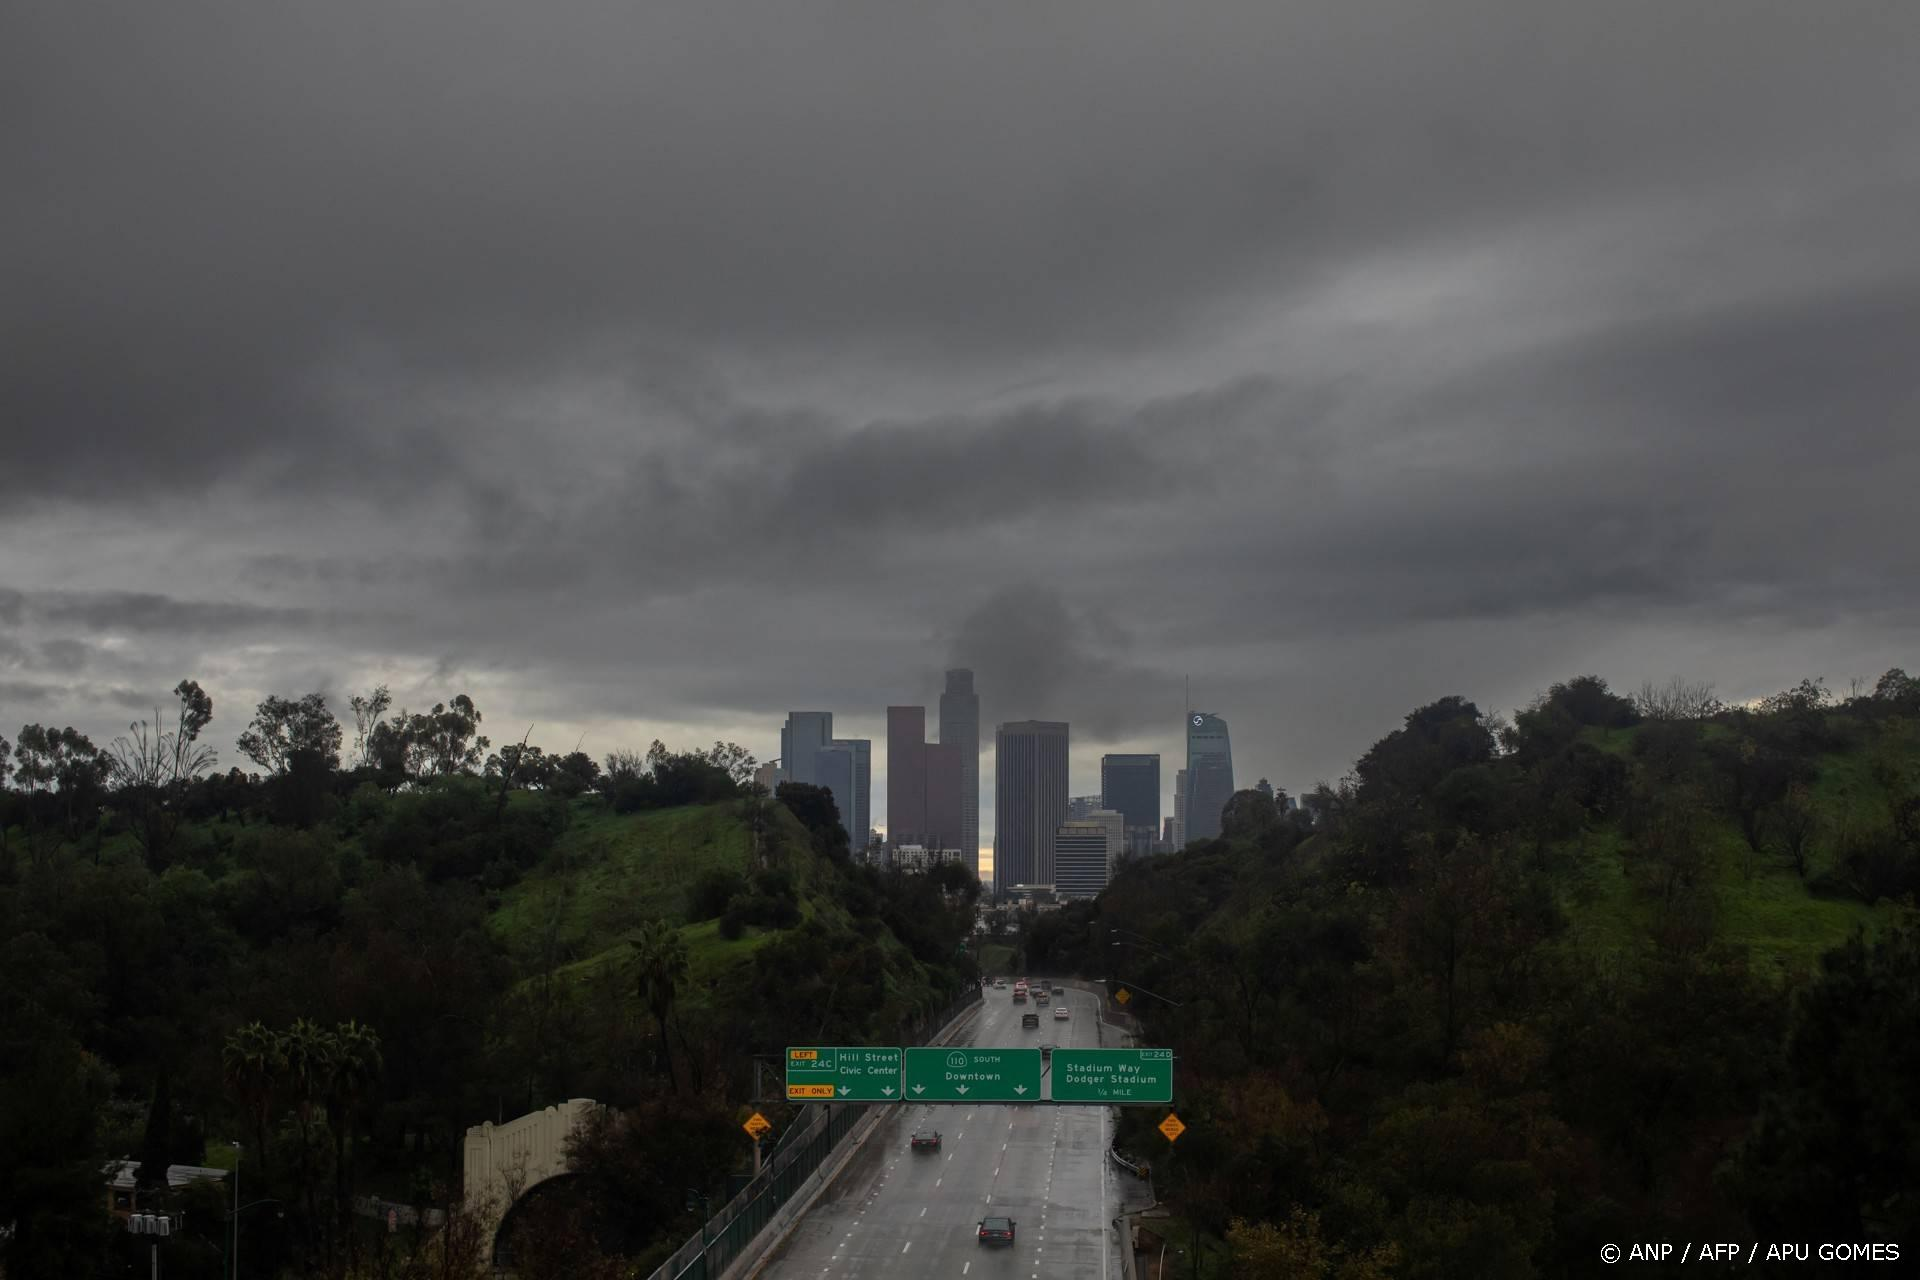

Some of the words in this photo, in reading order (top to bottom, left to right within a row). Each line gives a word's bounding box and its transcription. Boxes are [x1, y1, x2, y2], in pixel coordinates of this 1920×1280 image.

[839, 1053, 859, 1062] Hill
[865, 1053, 898, 1062] Street
[950, 1057, 964, 1066] 110
[811, 1060, 832, 1068] 24C
[1066, 1063, 1114, 1073] Stadium
[1118, 1064, 1141, 1074] Way
[839, 1066, 862, 1075] Civic
[867, 1066, 898, 1075] Center
[945, 1071, 1000, 1081] Downtown
[1066, 1075, 1105, 1085] Dodger
[1111, 1075, 1157, 1084] Stadium
[789, 1087, 805, 1095] EXIT
[811, 1087, 833, 1095] ONLY
[1112, 1088, 1132, 1096] MILE
